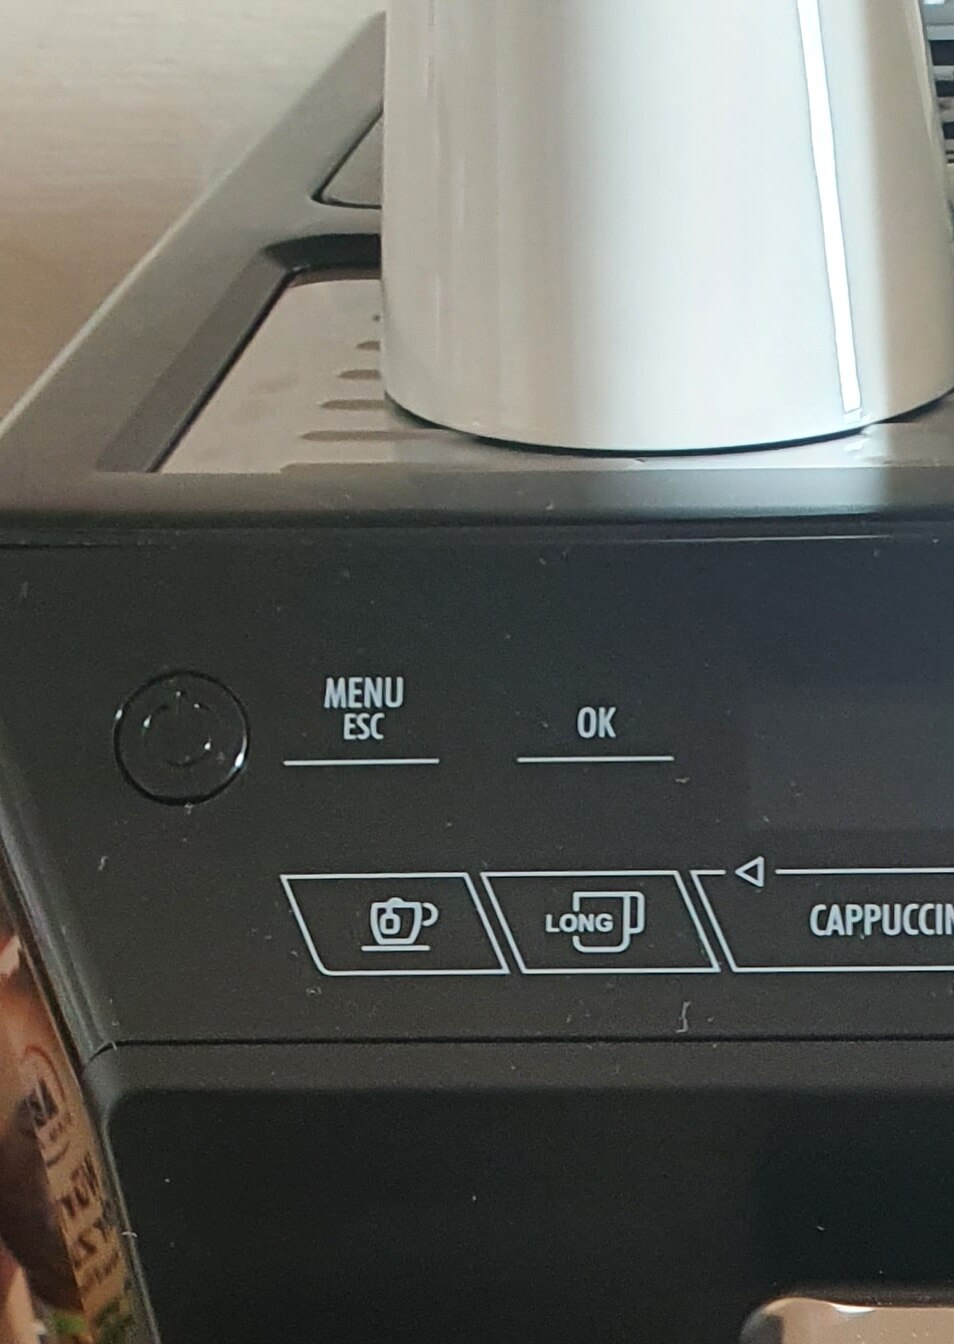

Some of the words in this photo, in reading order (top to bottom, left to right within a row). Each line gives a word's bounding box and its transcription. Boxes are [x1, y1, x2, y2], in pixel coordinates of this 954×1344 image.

[323, 676, 404, 709] MENU
[343, 712, 385, 741] ESC
[577, 706, 617, 739] OK
[545, 912, 614, 934] LONG
